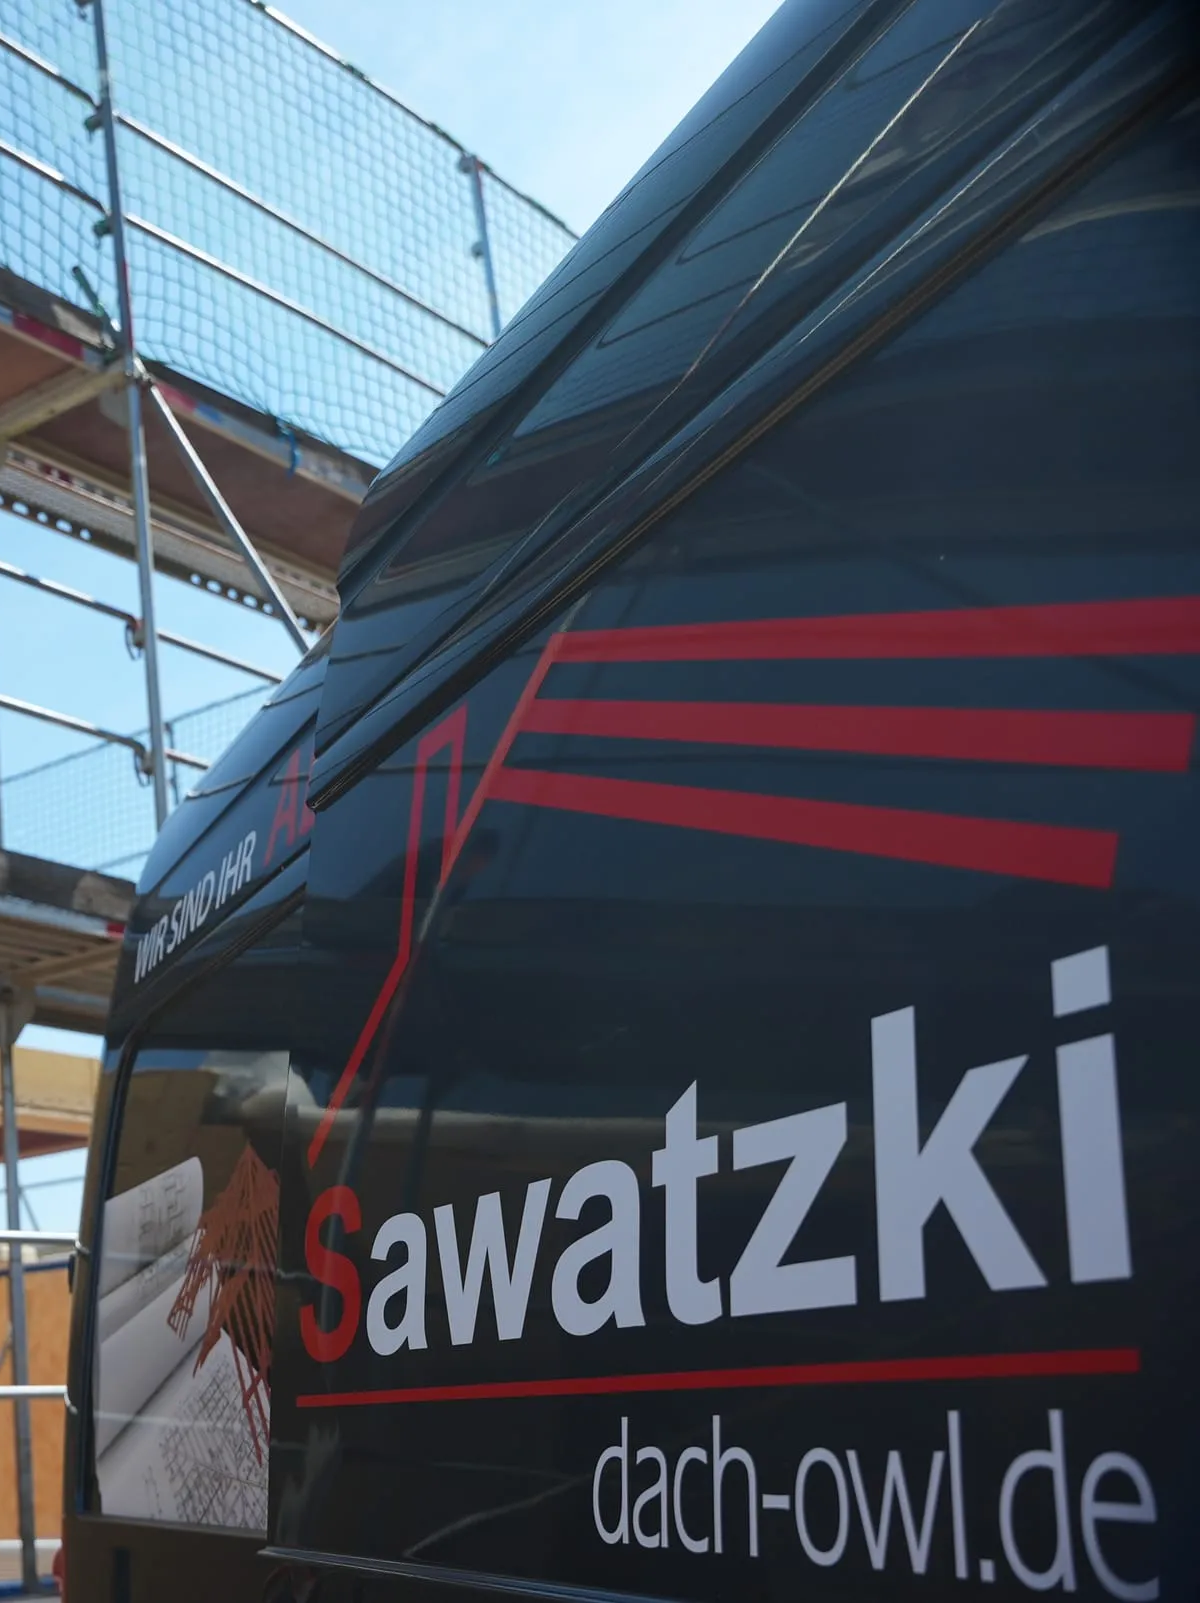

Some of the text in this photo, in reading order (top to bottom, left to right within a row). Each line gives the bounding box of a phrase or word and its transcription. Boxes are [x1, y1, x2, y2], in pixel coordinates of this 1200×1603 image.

[134, 914, 169, 984] WIR
[166, 870, 215, 954] SIND
[215, 830, 257, 910] IHR
[299, 945, 1133, 1363] Sawatzki
[592, 1409, 1160, 1601] dach-owl.de
